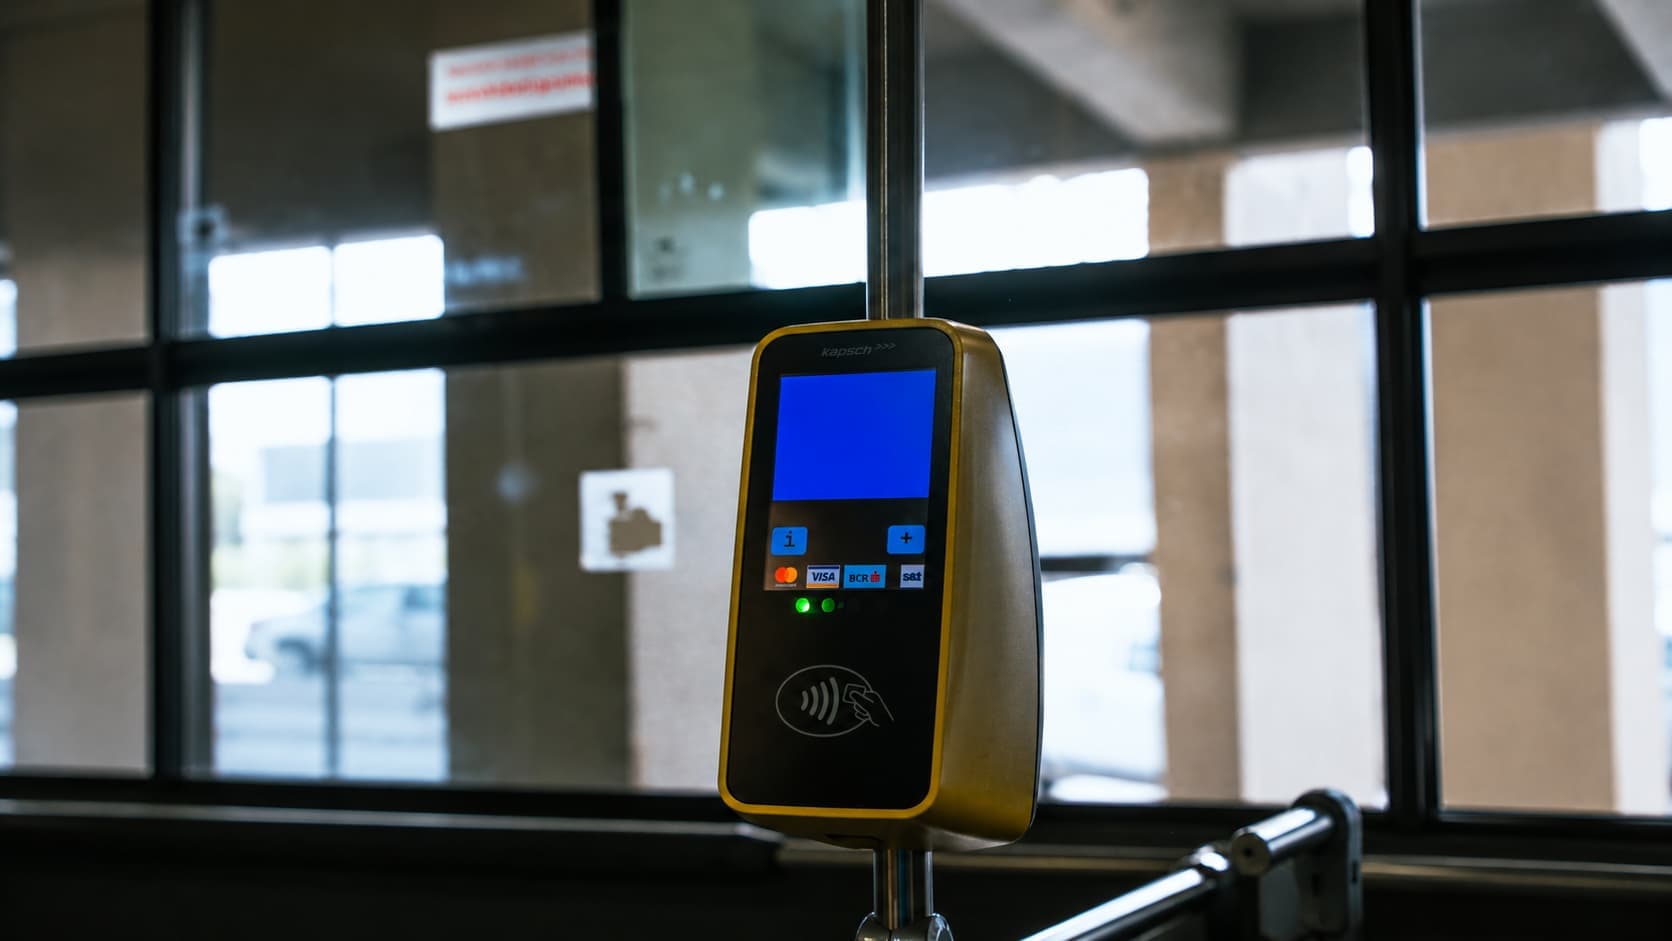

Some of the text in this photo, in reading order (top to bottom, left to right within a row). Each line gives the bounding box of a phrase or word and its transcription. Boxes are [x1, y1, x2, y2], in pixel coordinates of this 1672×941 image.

[822, 346, 873, 358] kapsch
[812, 571, 836, 582] VISA
[848, 573, 869, 583] BCR
